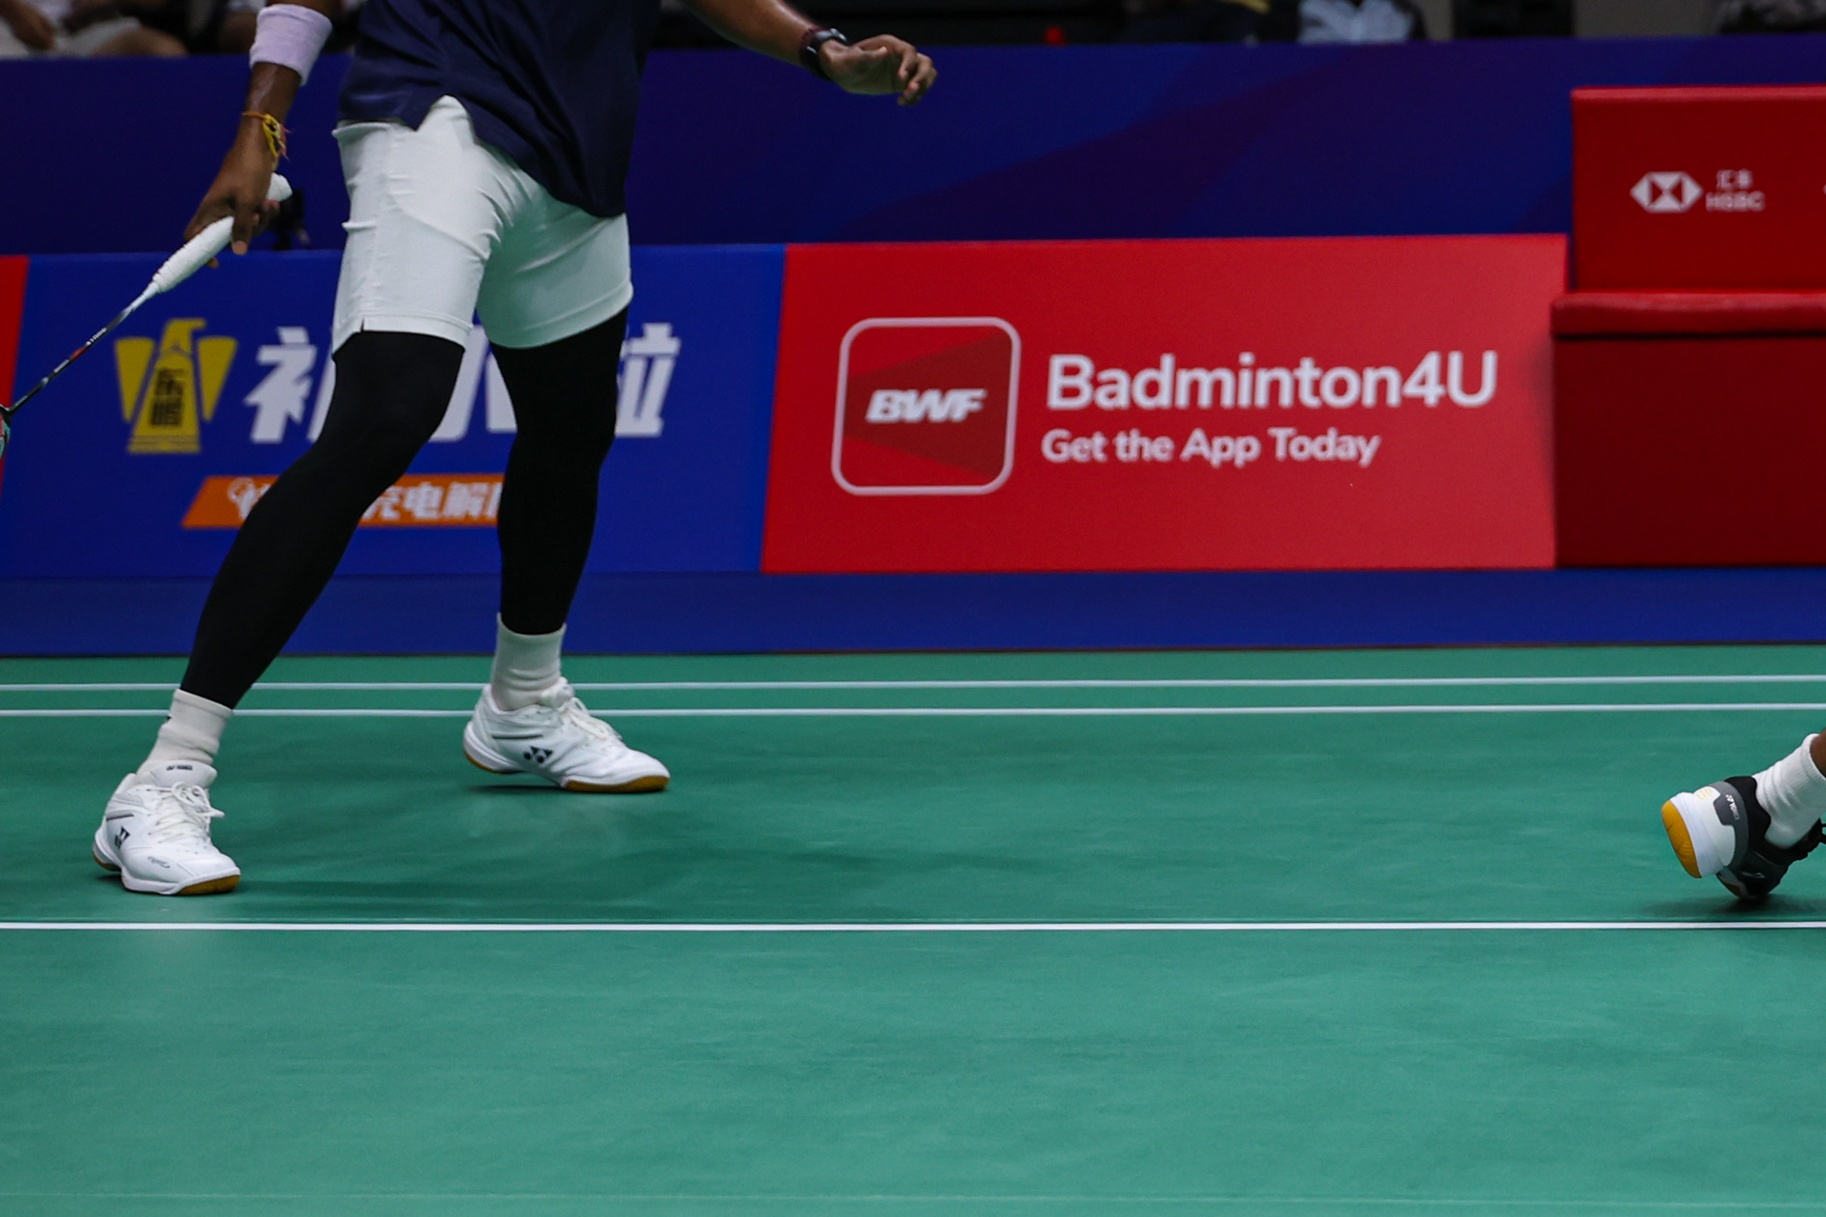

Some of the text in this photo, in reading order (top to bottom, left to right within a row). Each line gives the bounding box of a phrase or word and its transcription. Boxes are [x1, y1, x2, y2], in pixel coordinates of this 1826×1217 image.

[1046, 350, 1499, 410] Badminton4U
[864, 387, 988, 424] BWF
[1040, 426, 1382, 469] Get the App Today
